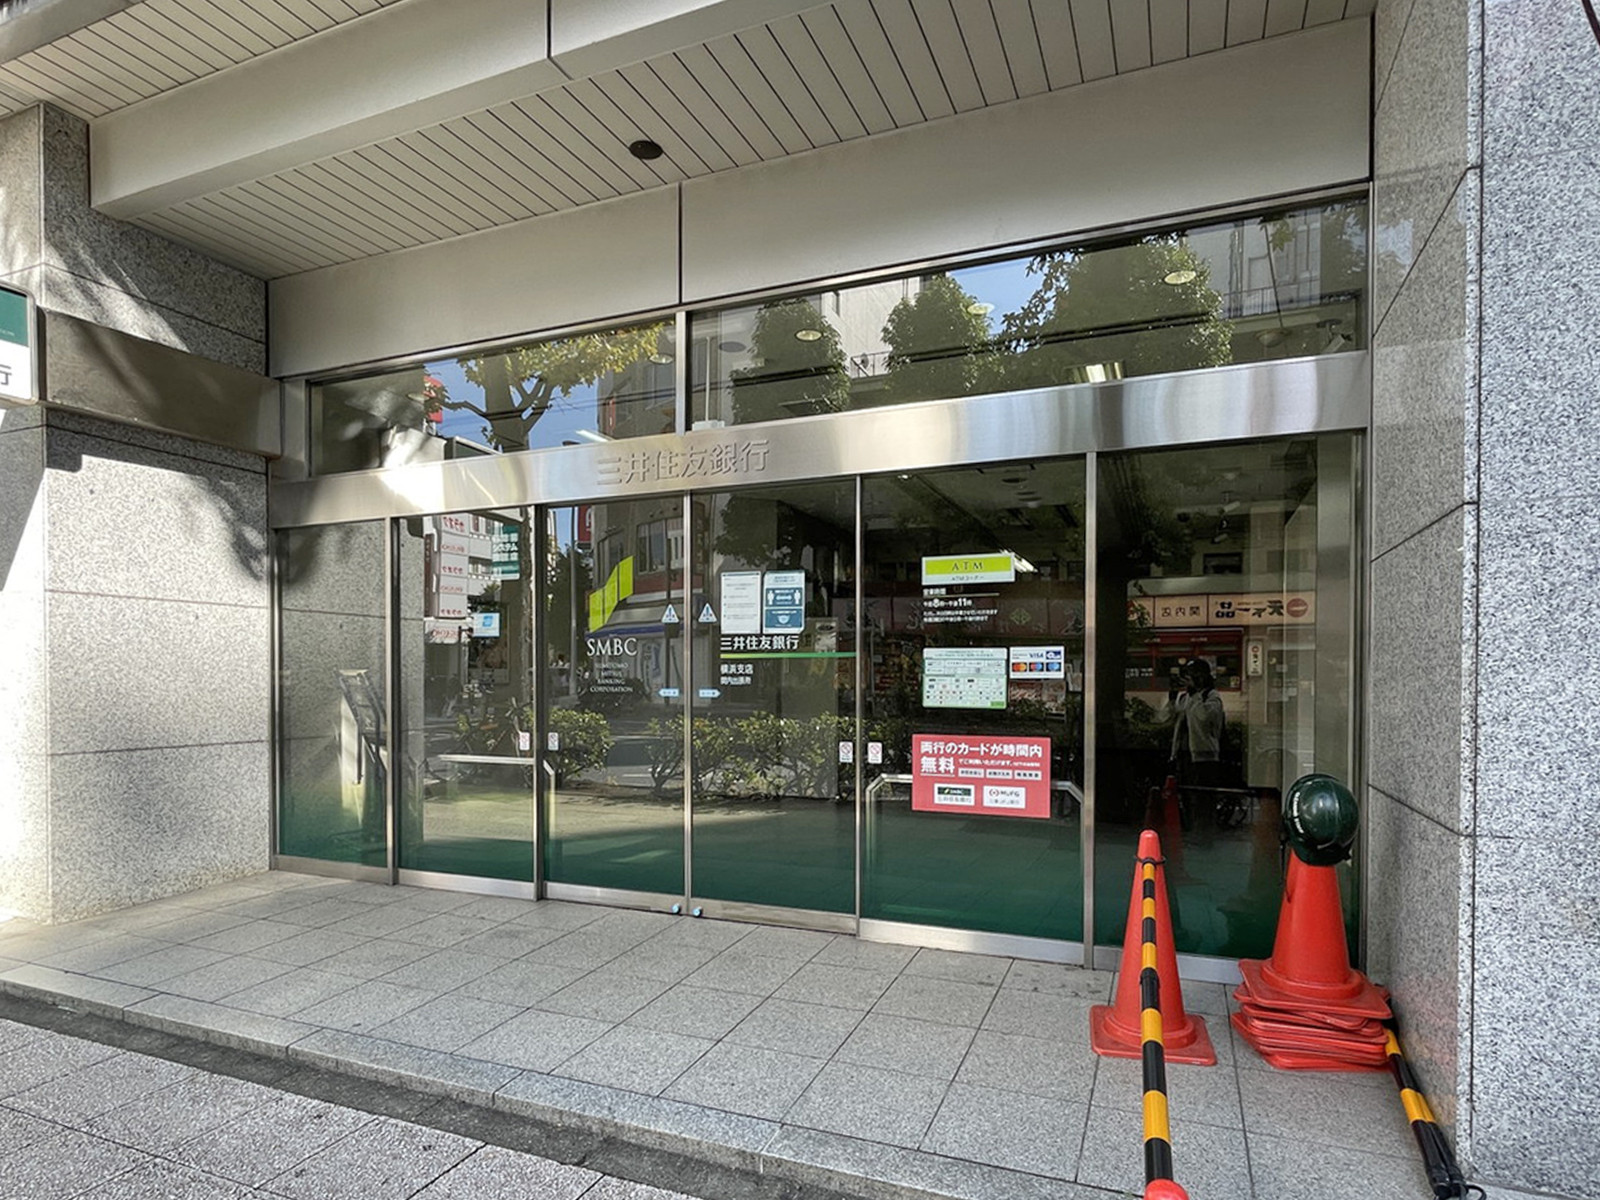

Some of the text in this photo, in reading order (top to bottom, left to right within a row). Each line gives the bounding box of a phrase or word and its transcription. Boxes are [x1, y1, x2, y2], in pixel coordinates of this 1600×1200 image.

[597, 439, 770, 486] 三井住友銀行
[951, 561, 983, 571] ATM
[586, 637, 638, 657] SMBC
[720, 635, 800, 650] 三井住友銀行
[920, 741, 1043, 758] 両行のカードが時間内
[920, 755, 956, 774] 無料
